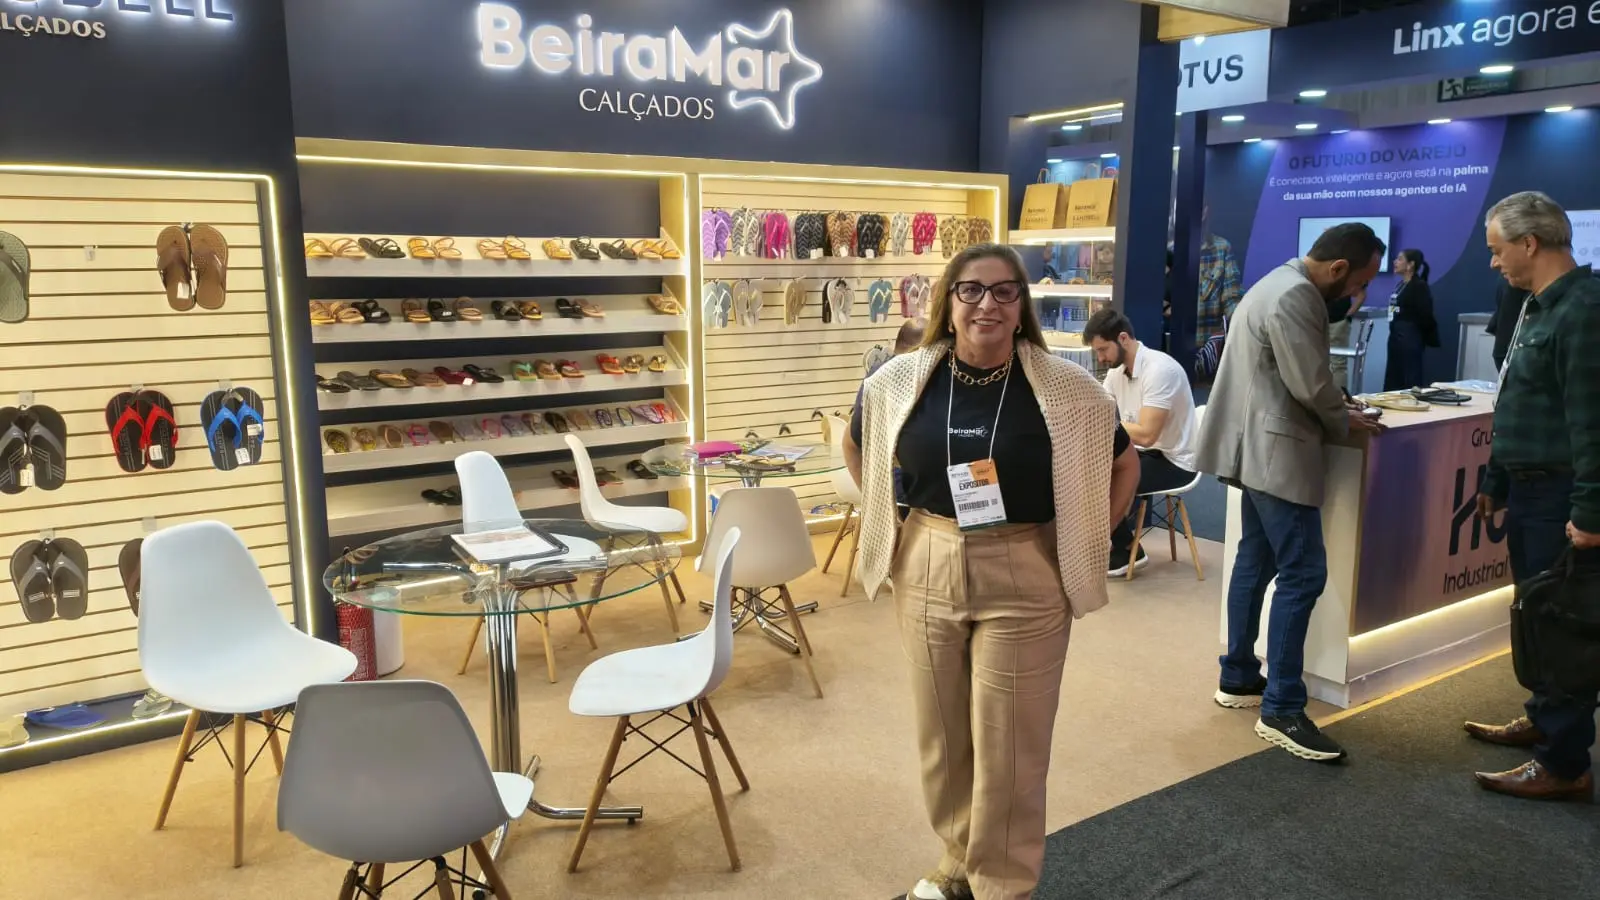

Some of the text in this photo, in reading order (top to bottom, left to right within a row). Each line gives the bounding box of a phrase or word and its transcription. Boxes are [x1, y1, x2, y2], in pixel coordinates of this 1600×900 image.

[0, 12, 106, 39] LÇADOS
[1393, 21, 1465, 54] Linx
[1471, 5, 1576, 46] agora
[479, 2, 790, 91] BeiraMar
[1178, 54, 1244, 88] TVS
[578, 88, 715, 121] CALÇADOS
[1289, 146, 1467, 170] O FUTURO DO VAREJO
[1383, 169, 1413, 182] agora
[1414, 166, 1437, 178] está
[1438, 167, 1452, 177] na
[1453, 164, 1489, 178] palma
[1283, 182, 1467, 201] da sua mão com nossos agentes de IA
[1443, 556, 1508, 594] Industrial
